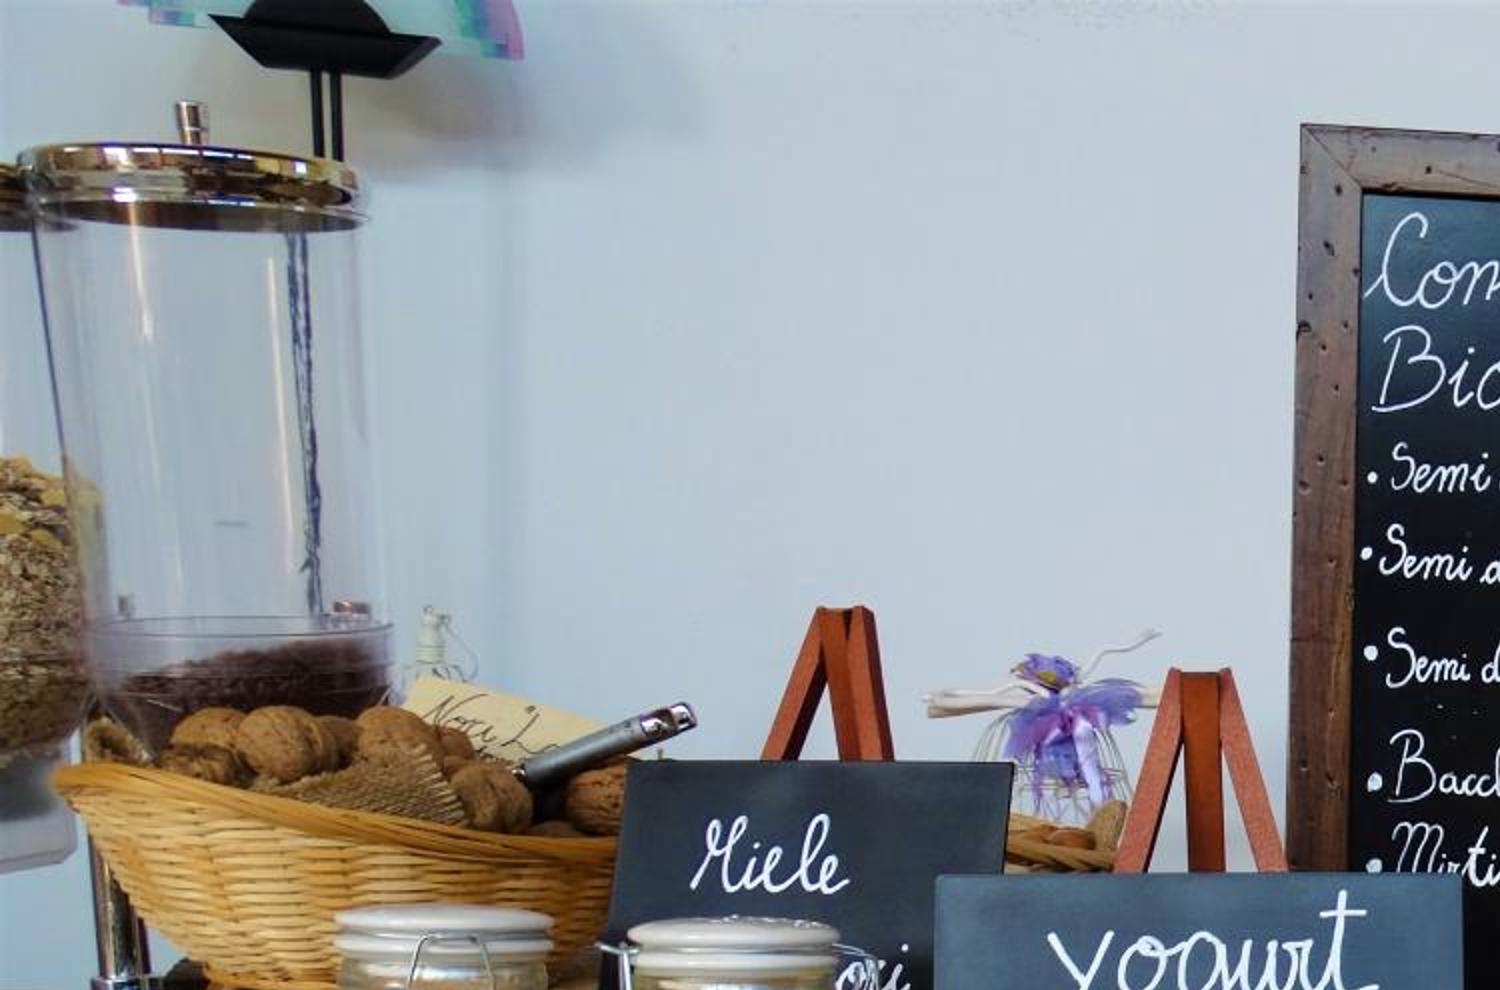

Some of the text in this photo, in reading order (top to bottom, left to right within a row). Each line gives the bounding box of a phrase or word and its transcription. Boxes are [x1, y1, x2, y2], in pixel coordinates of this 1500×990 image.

[1391, 442, 1491, 493] Semi
[1379, 523, 1473, 581] Semi
[1385, 626, 1471, 689] Semi
[689, 813, 850, 895] Miele
